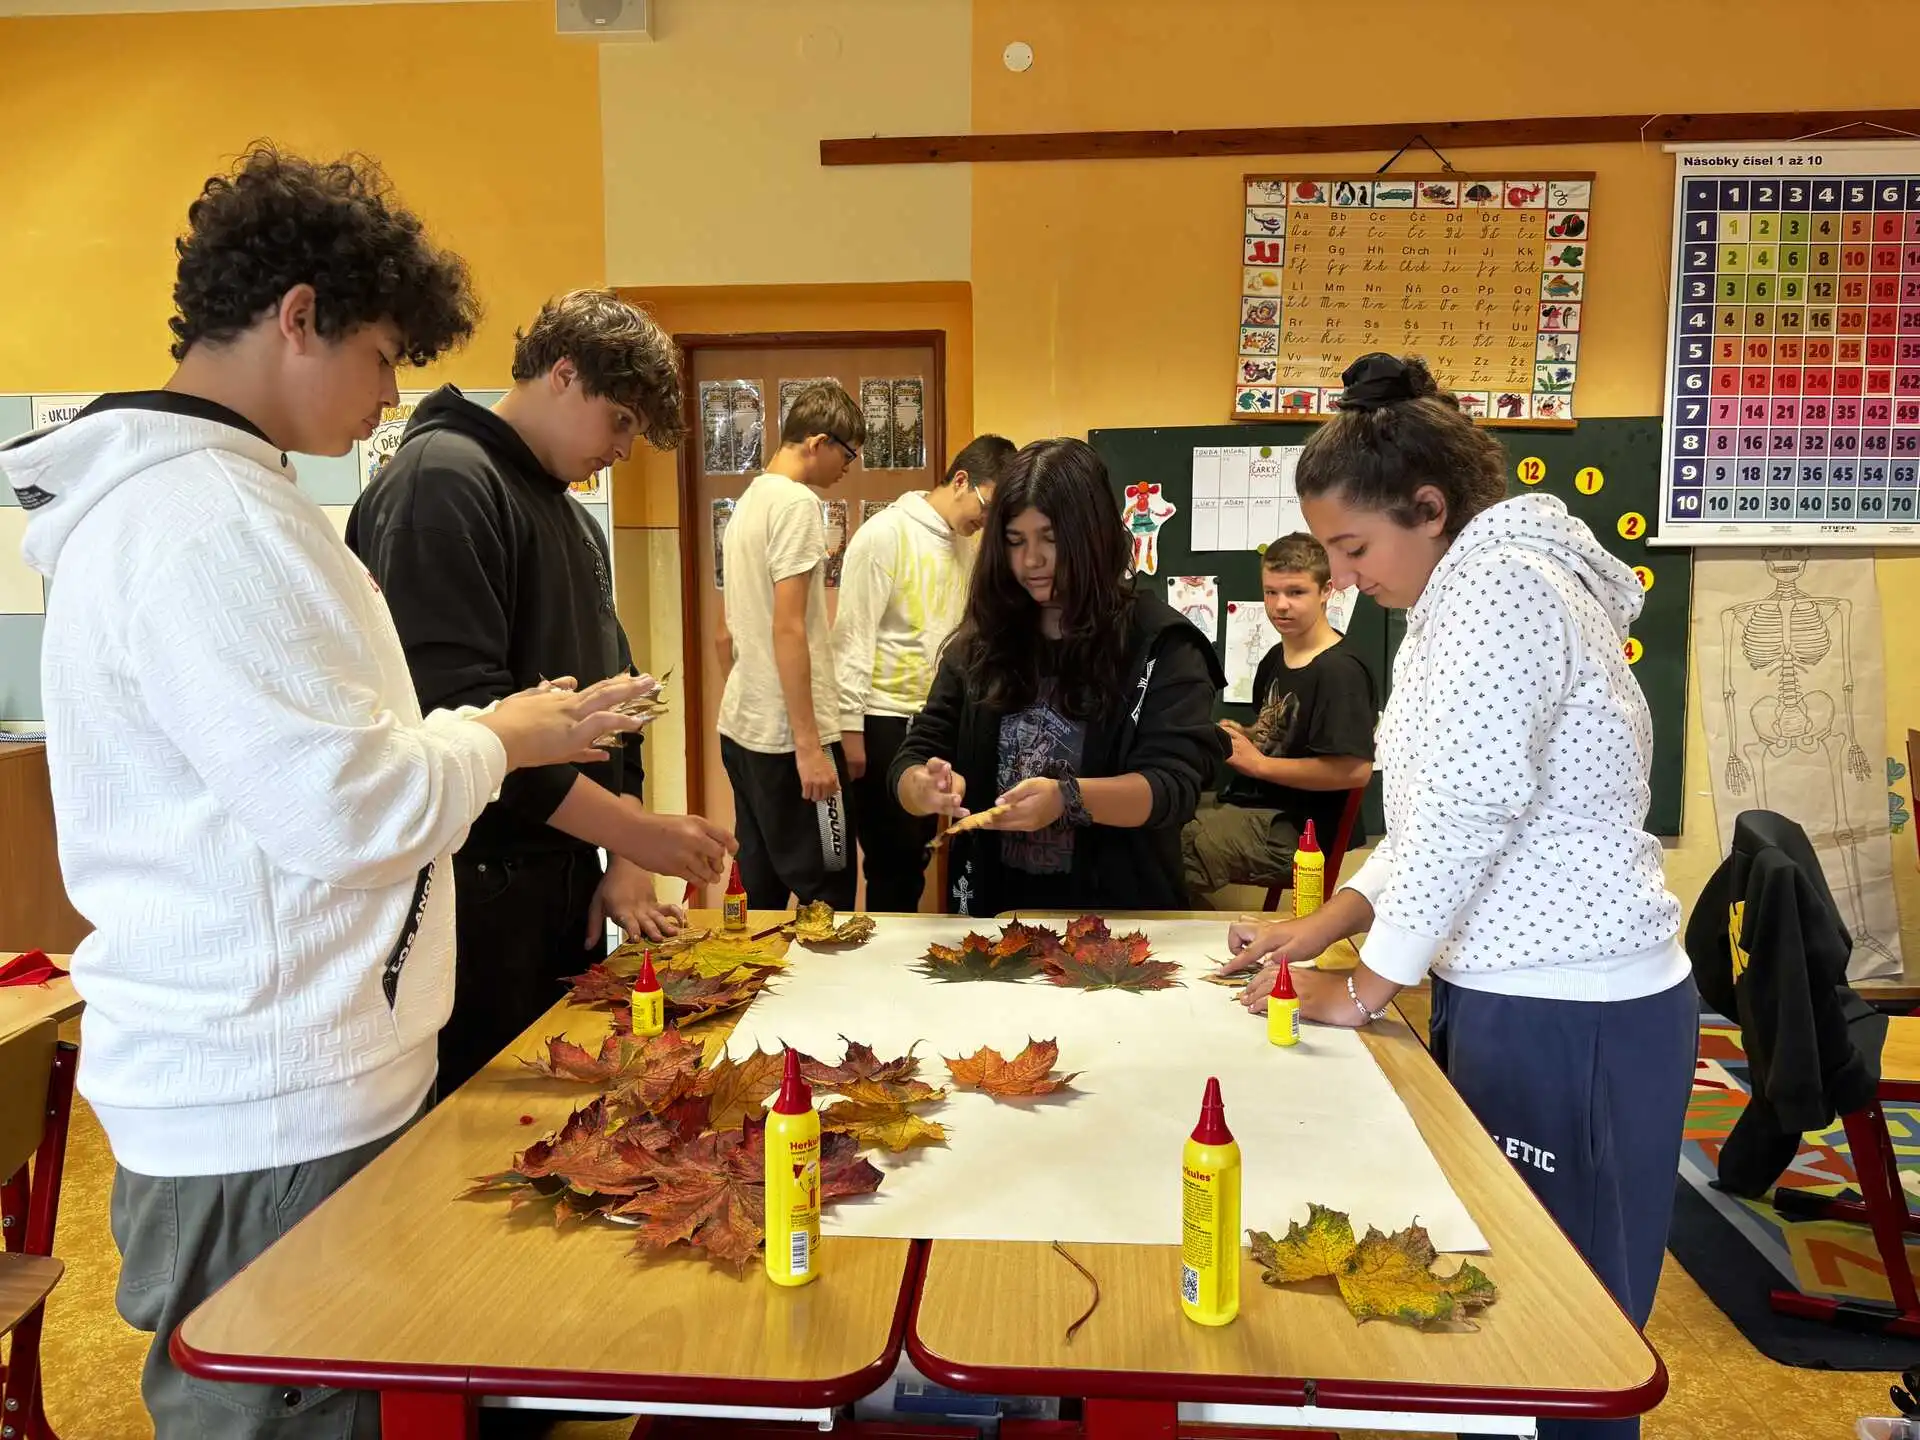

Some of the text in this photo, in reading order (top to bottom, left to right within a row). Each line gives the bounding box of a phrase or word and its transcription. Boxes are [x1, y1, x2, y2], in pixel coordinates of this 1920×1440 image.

[1684, 156, 1823, 168] Násobky čísel 1 až 10
[1729, 188, 1739, 202] 1
[1760, 188, 1772, 201] 2
[1790, 188, 1802, 202] 3
[1819, 188, 1834, 202] 4
[1851, 188, 1864, 202] 5
[1883, 188, 1898, 201] 6
[1696, 220, 1893, 235] 1 1 2 3 4 5 6
[1694, 252, 1707, 265] 2
[1728, 251, 1737, 265] 2
[1758, 251, 1768, 265] 4
[1789, 252, 1798, 265] 6
[1819, 252, 1829, 266] 8
[1846, 252, 1865, 266] 10
[1878, 252, 1895, 265] 12
[1692, 282, 1705, 296] 3
[1727, 282, 1735, 296] 3
[1757, 283, 1766, 296] 6
[1787, 283, 1796, 296] 9
[1814, 283, 1831, 296] 12
[1844, 283, 1862, 297] 15
[1690, 313, 1705, 327] 4
[1725, 313, 1734, 326] 4
[1755, 313, 1764, 327] 8
[1782, 313, 1799, 326] 12
[1812, 313, 1829, 327] 16
[1842, 313, 1862, 327] 20
[1873, 313, 1892, 327] 24
[1689, 344, 1702, 358] 5
[1724, 343, 1732, 357] 5
[1748, 344, 1767, 357] 10
[1780, 344, 1797, 357] 15
[1809, 344, 1829, 358] 20
[1840, 344, 1860, 358] 25
[1871, 344, 1891, 358] 30
[1687, 374, 1920, 389] 6 6 12 18 24 30 36 42
[48, 405, 84, 422] UKLID
[1686, 405, 1919, 419] 7 7 14 21 28 35 42 49
[1683, 435, 1916, 450] 8 8 16 24 32 40 48 56
[1523, 462, 1540, 480] 12
[1682, 466, 1913, 481] 9 9 18 27 36 45 54 63
[1586, 472, 1594, 490] 1
[1677, 496, 1911, 511] 10 10 20 30 40 50 60 70
[1625, 517, 1638, 536] 2
[1623, 642, 1633, 660] 4
[826, 796, 841, 856] SQUAD
[390, 931, 415, 974] LOS
[1493, 1135, 1556, 1173] ETIC
